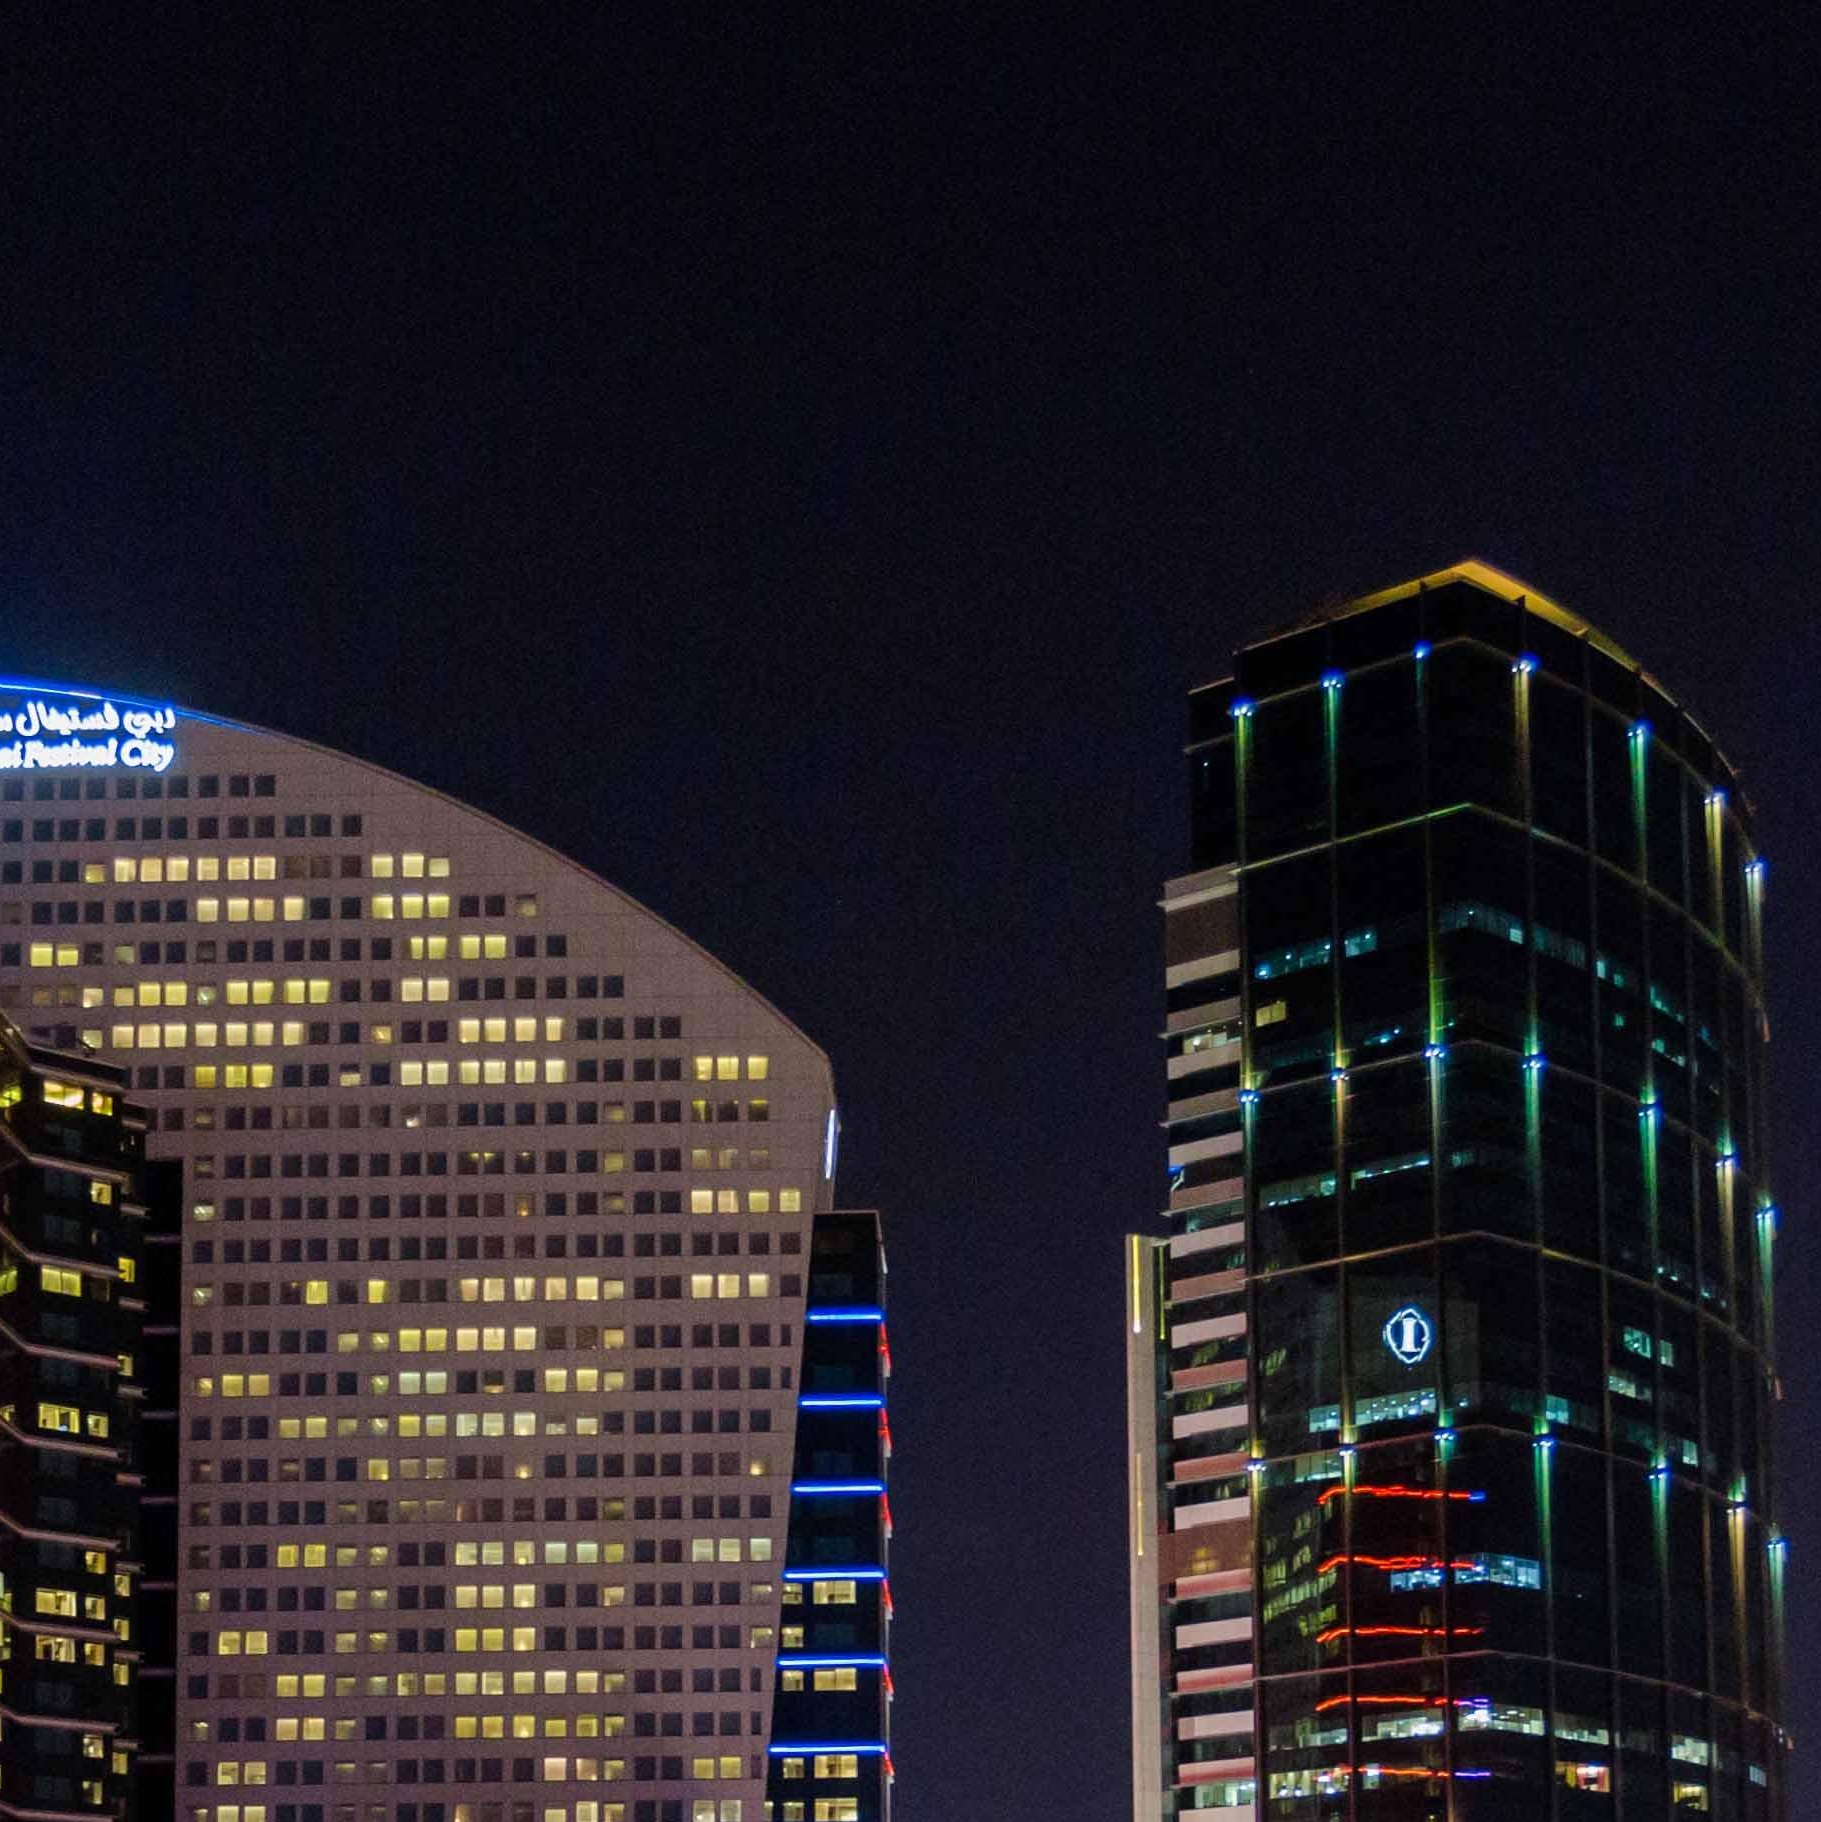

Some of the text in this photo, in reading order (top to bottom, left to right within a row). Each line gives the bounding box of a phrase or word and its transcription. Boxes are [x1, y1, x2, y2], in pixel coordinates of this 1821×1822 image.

[123, 707, 175, 739] دبي
[23, 738, 118, 769] Festival
[120, 739, 175, 772] City
